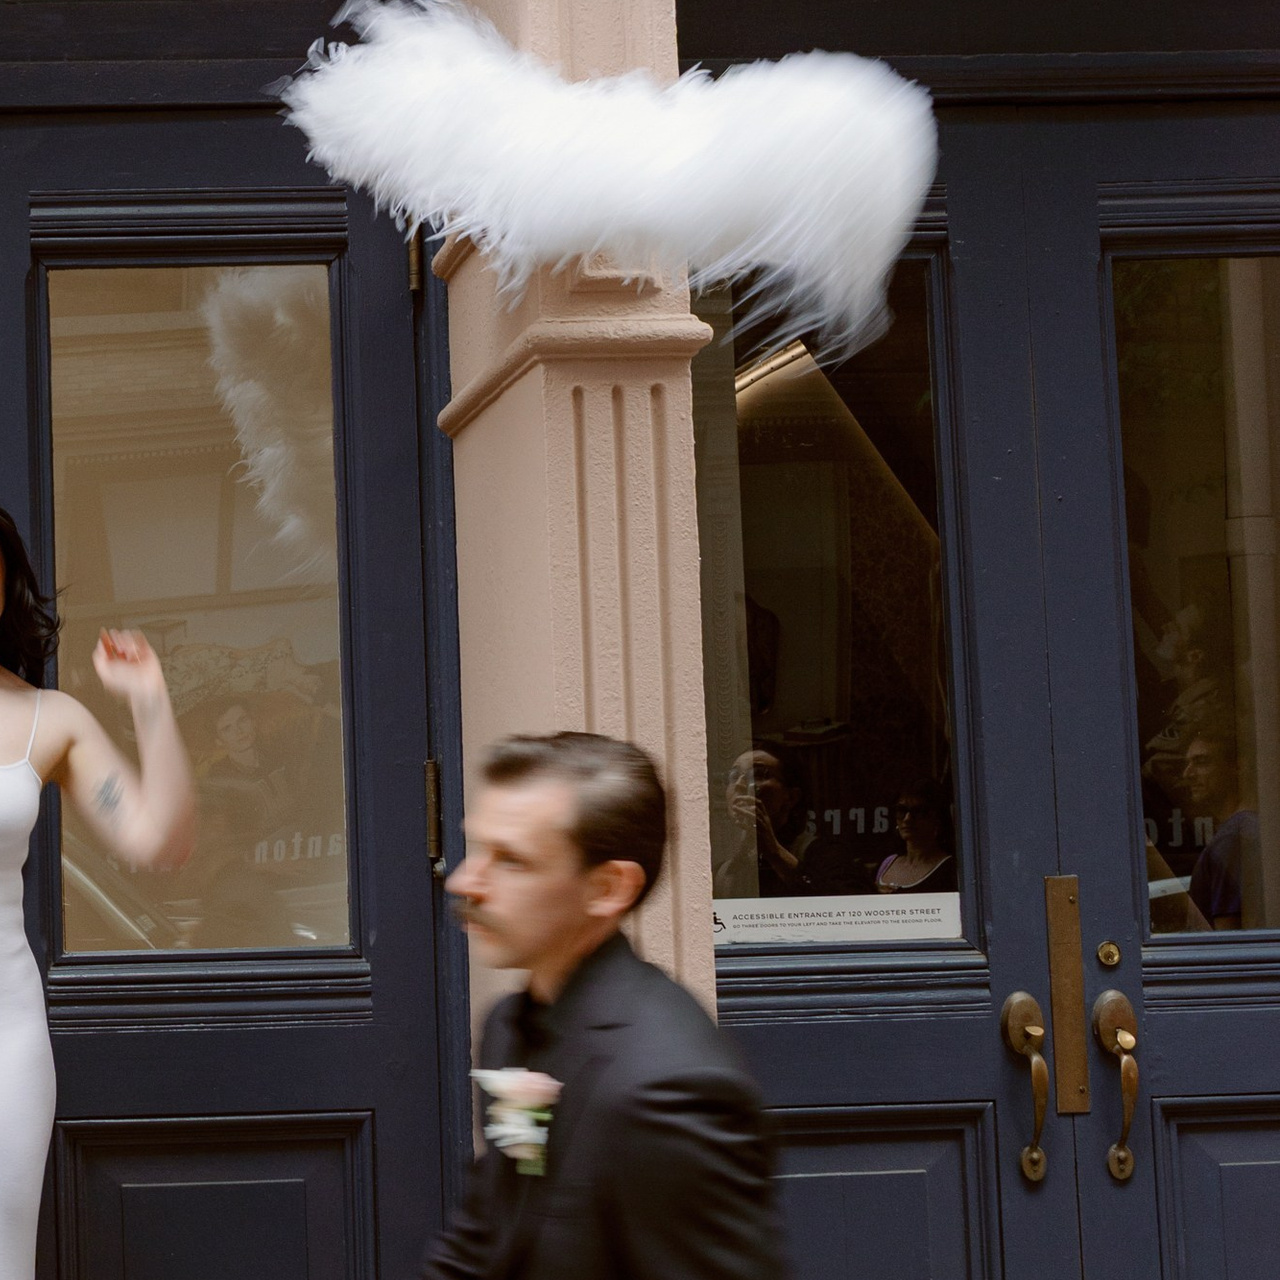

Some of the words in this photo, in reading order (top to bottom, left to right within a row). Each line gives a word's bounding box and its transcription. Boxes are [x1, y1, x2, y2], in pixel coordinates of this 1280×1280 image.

[732, 912, 785, 921] ACCESSIBLE
[787, 911, 833, 919] ENTRANCE
[835, 910, 846, 918] AT
[864, 909, 907, 917] WOOSTER
[909, 908, 941, 916] STREET
